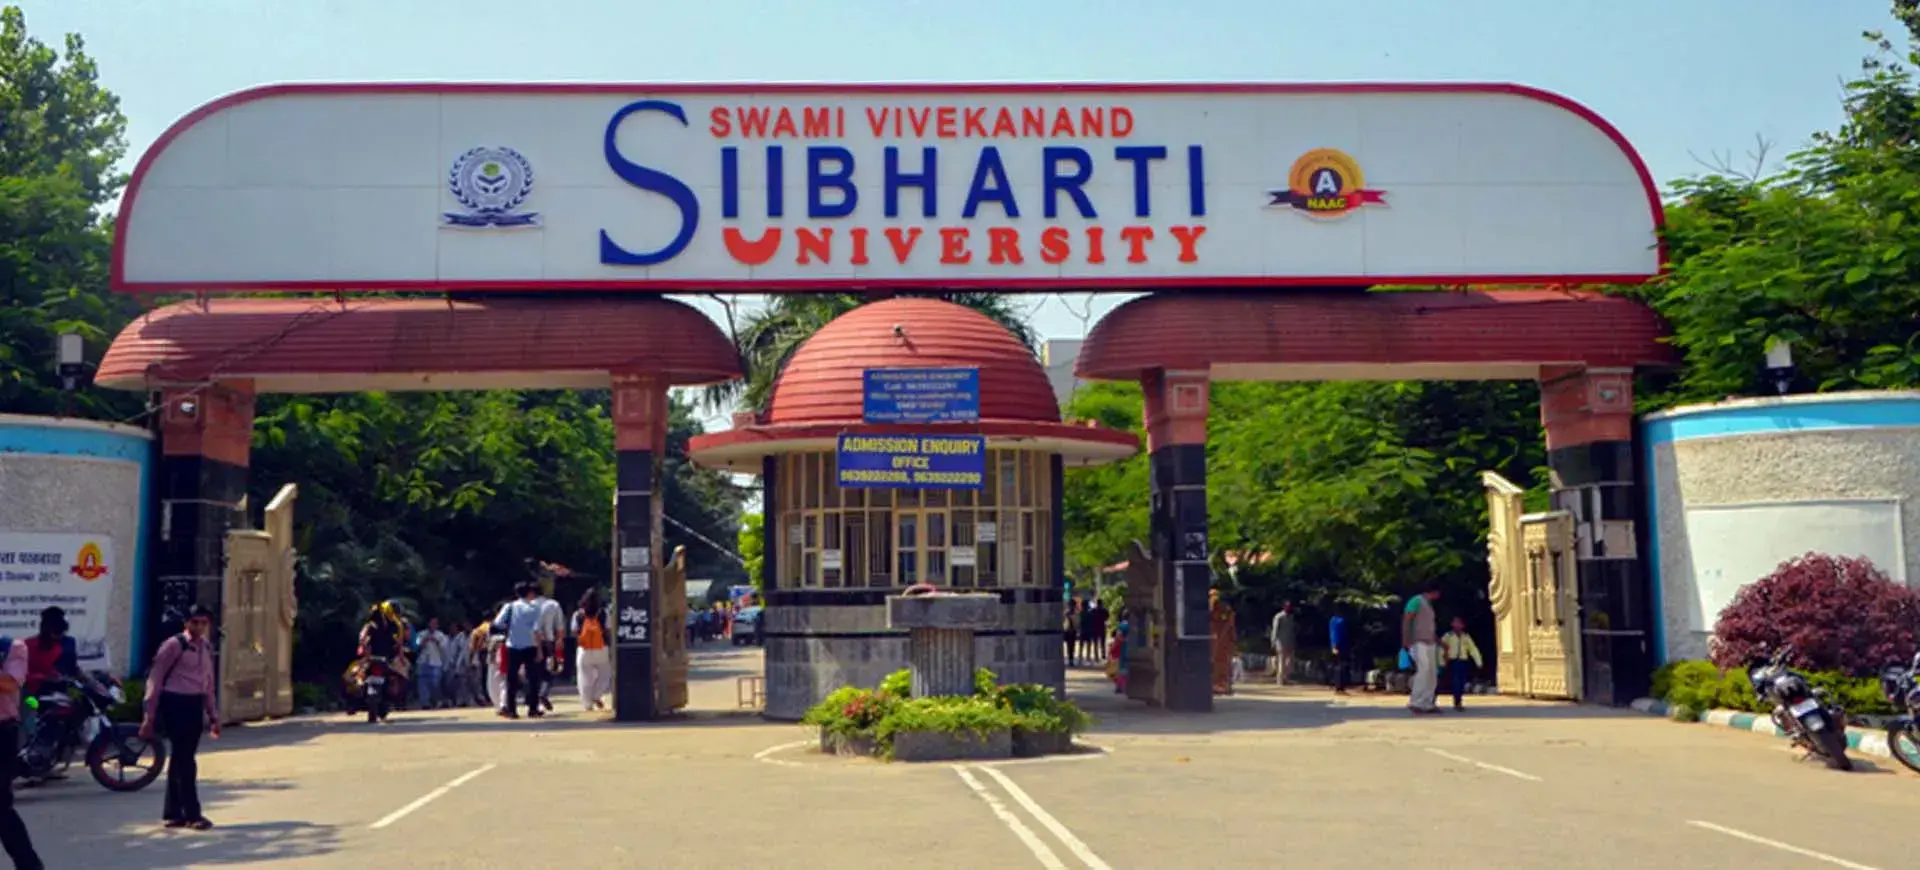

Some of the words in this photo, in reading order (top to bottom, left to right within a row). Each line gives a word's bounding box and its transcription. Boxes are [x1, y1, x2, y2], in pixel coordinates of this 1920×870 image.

[709, 106, 846, 138] SWAMI
[865, 106, 1135, 138] VIVEKANAND
[1316, 170, 1337, 193] A
[1307, 197, 1346, 209] NAAC
[721, 226, 1207, 265] UNIVERSITY
[842, 437, 919, 453] ADMISSION
[921, 438, 980, 455] ENQUIRY
[892, 457, 929, 469] OFFICE
